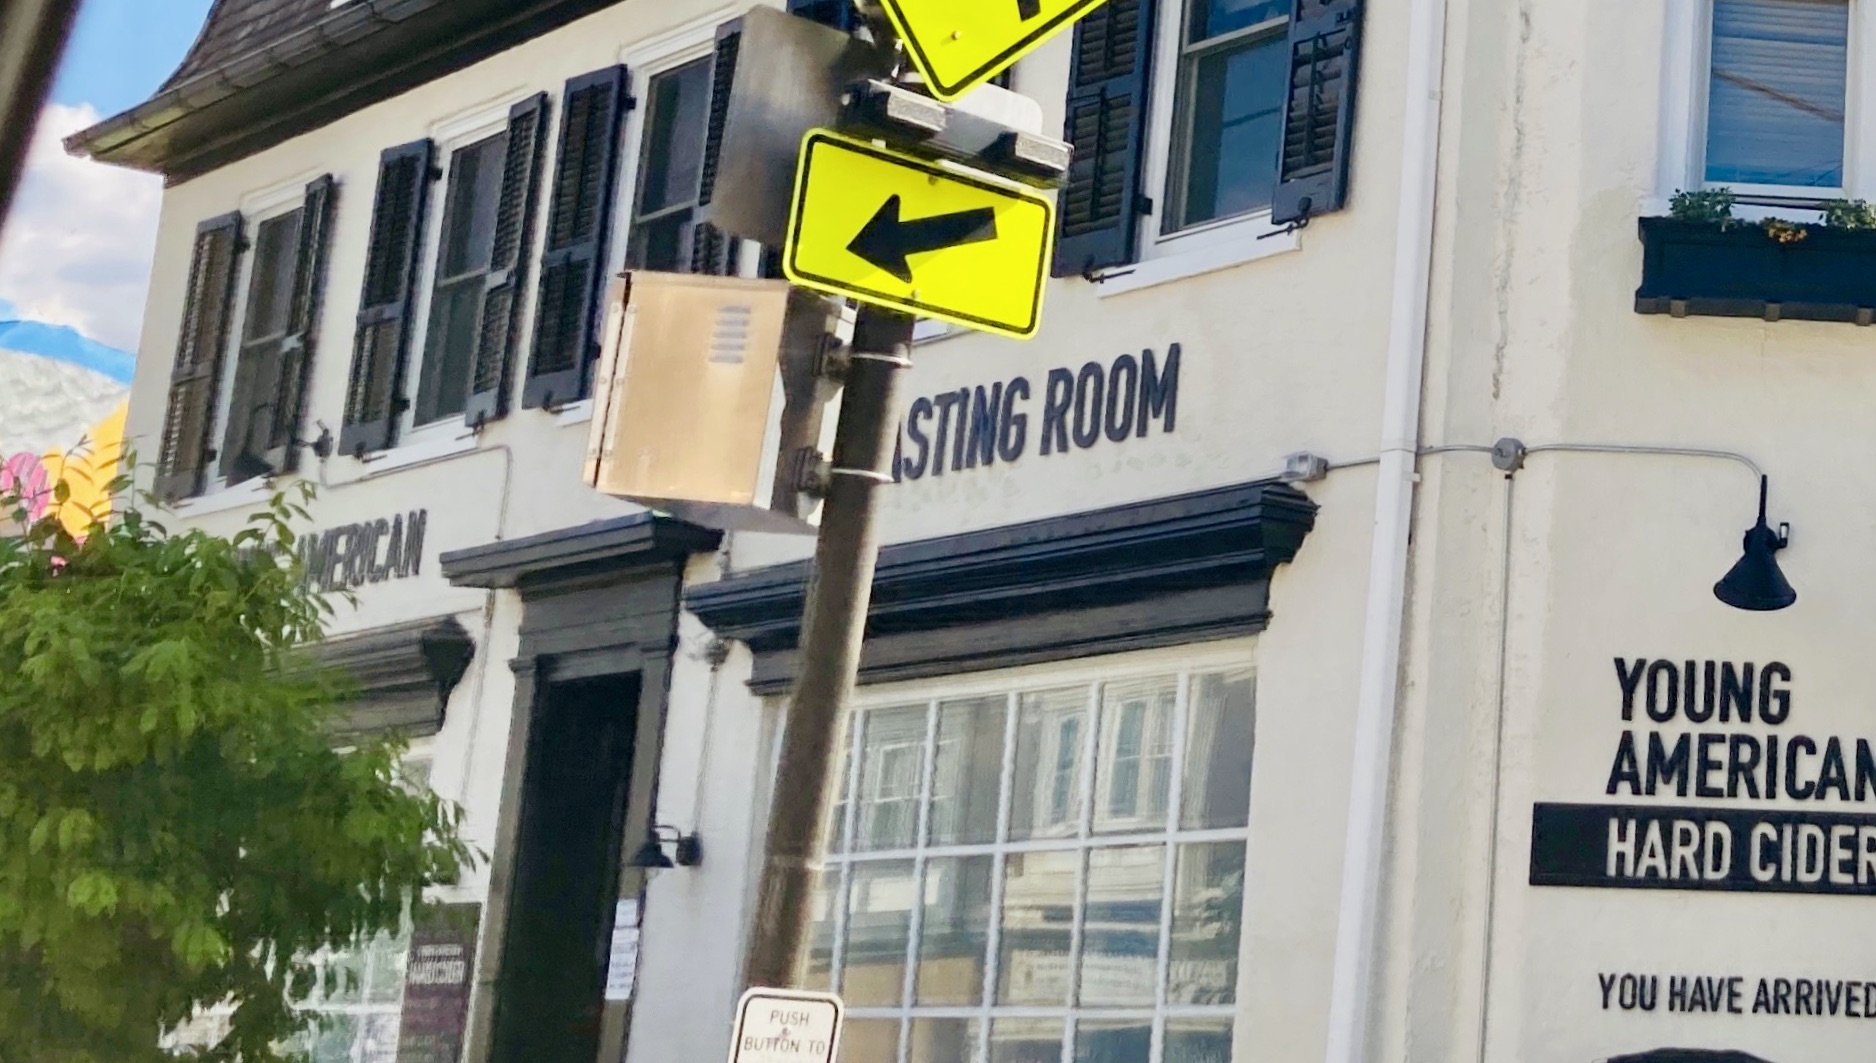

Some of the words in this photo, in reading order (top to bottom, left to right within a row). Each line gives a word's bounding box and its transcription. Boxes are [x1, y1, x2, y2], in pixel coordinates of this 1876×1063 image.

[892, 376, 1030, 484] STING
[1039, 342, 1181, 456] ROOM
[1613, 657, 1791, 725] YOUNG
[1605, 817, 1732, 881] HARD
[769, 1009, 810, 1027] PUSH
[1598, 972, 1658, 1011] YOU
[1668, 975, 1744, 1014] HAVE
[743, 1036, 801, 1053] BUTTON
[808, 1039, 826, 1056] TO
